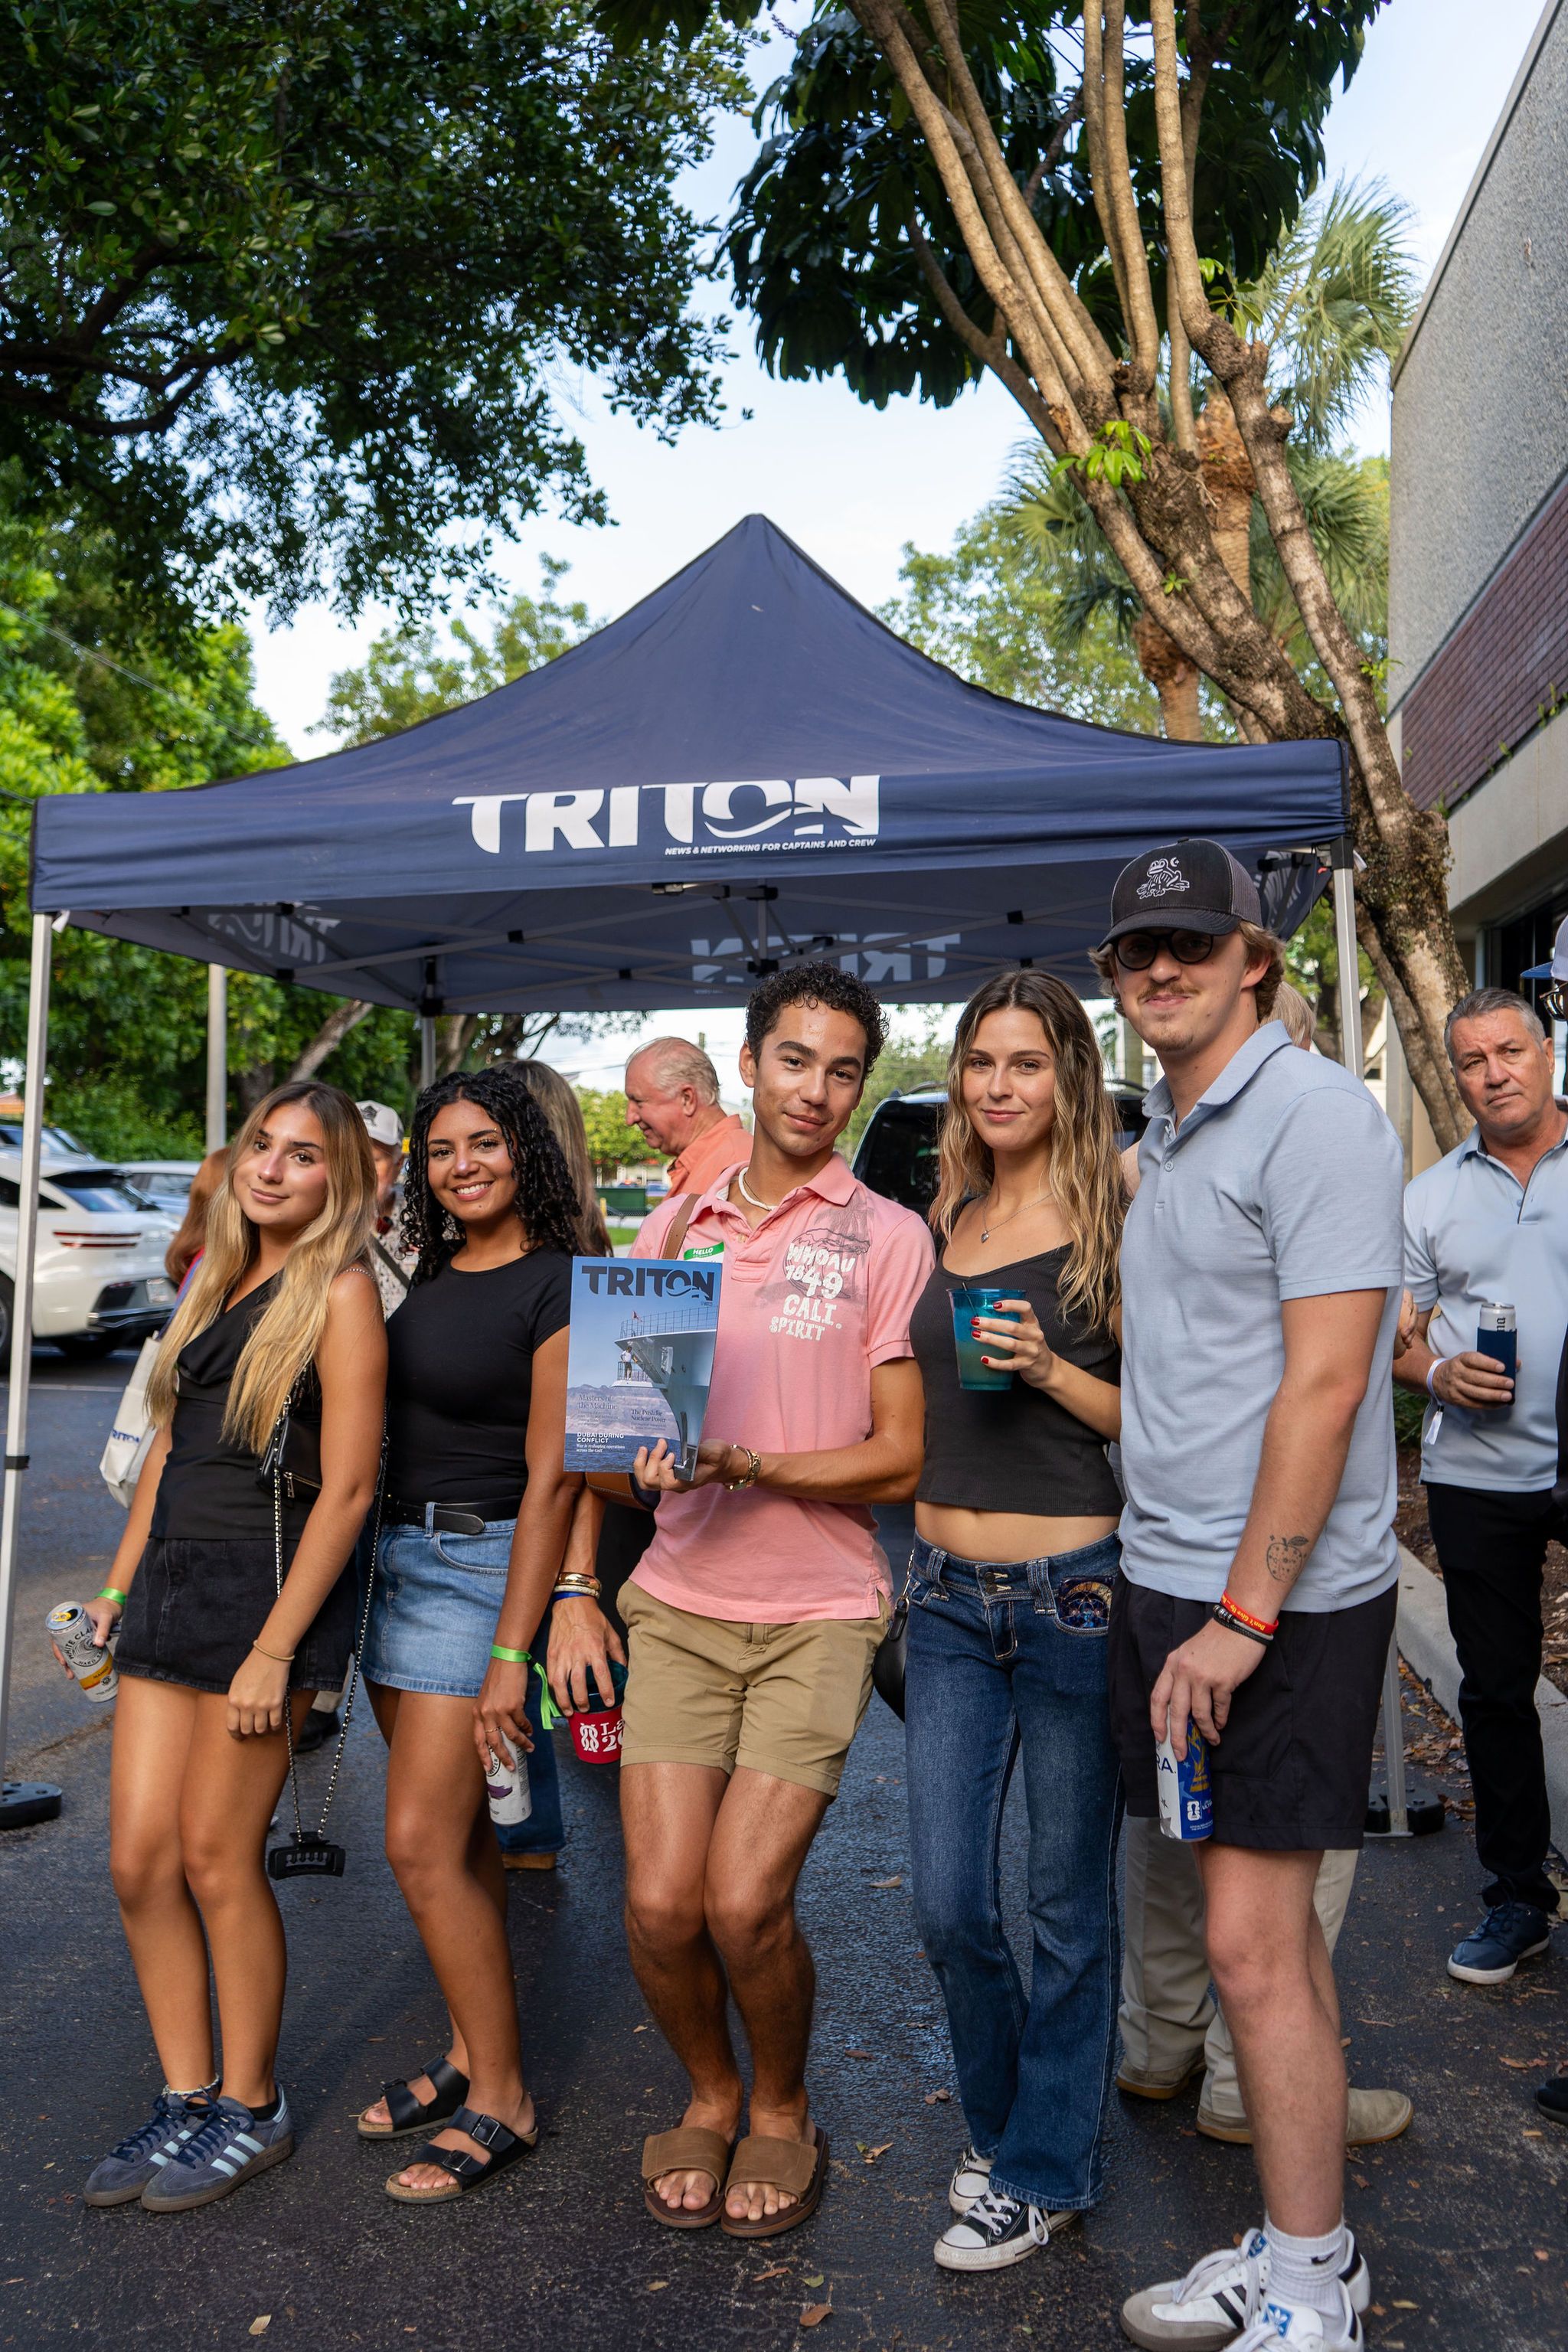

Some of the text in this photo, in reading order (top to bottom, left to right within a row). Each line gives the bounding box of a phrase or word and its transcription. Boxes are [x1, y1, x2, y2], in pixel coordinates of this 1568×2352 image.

[452, 775, 880, 854] TRITON
[665, 838, 876, 855] NEWS & NETWORKING FOR CAPTAINS AND CREW
[693, 1247, 714, 1256] HELLO
[582, 1266, 714, 1302] TRITON
[769, 1316, 825, 1341] SPIRIT
[1230, 1604, 1237, 1613] Up
[1236, 1611, 1249, 1622] Give
[1250, 1619, 1266, 1631] Don't
[64, 1639, 76, 1660] WHITE
